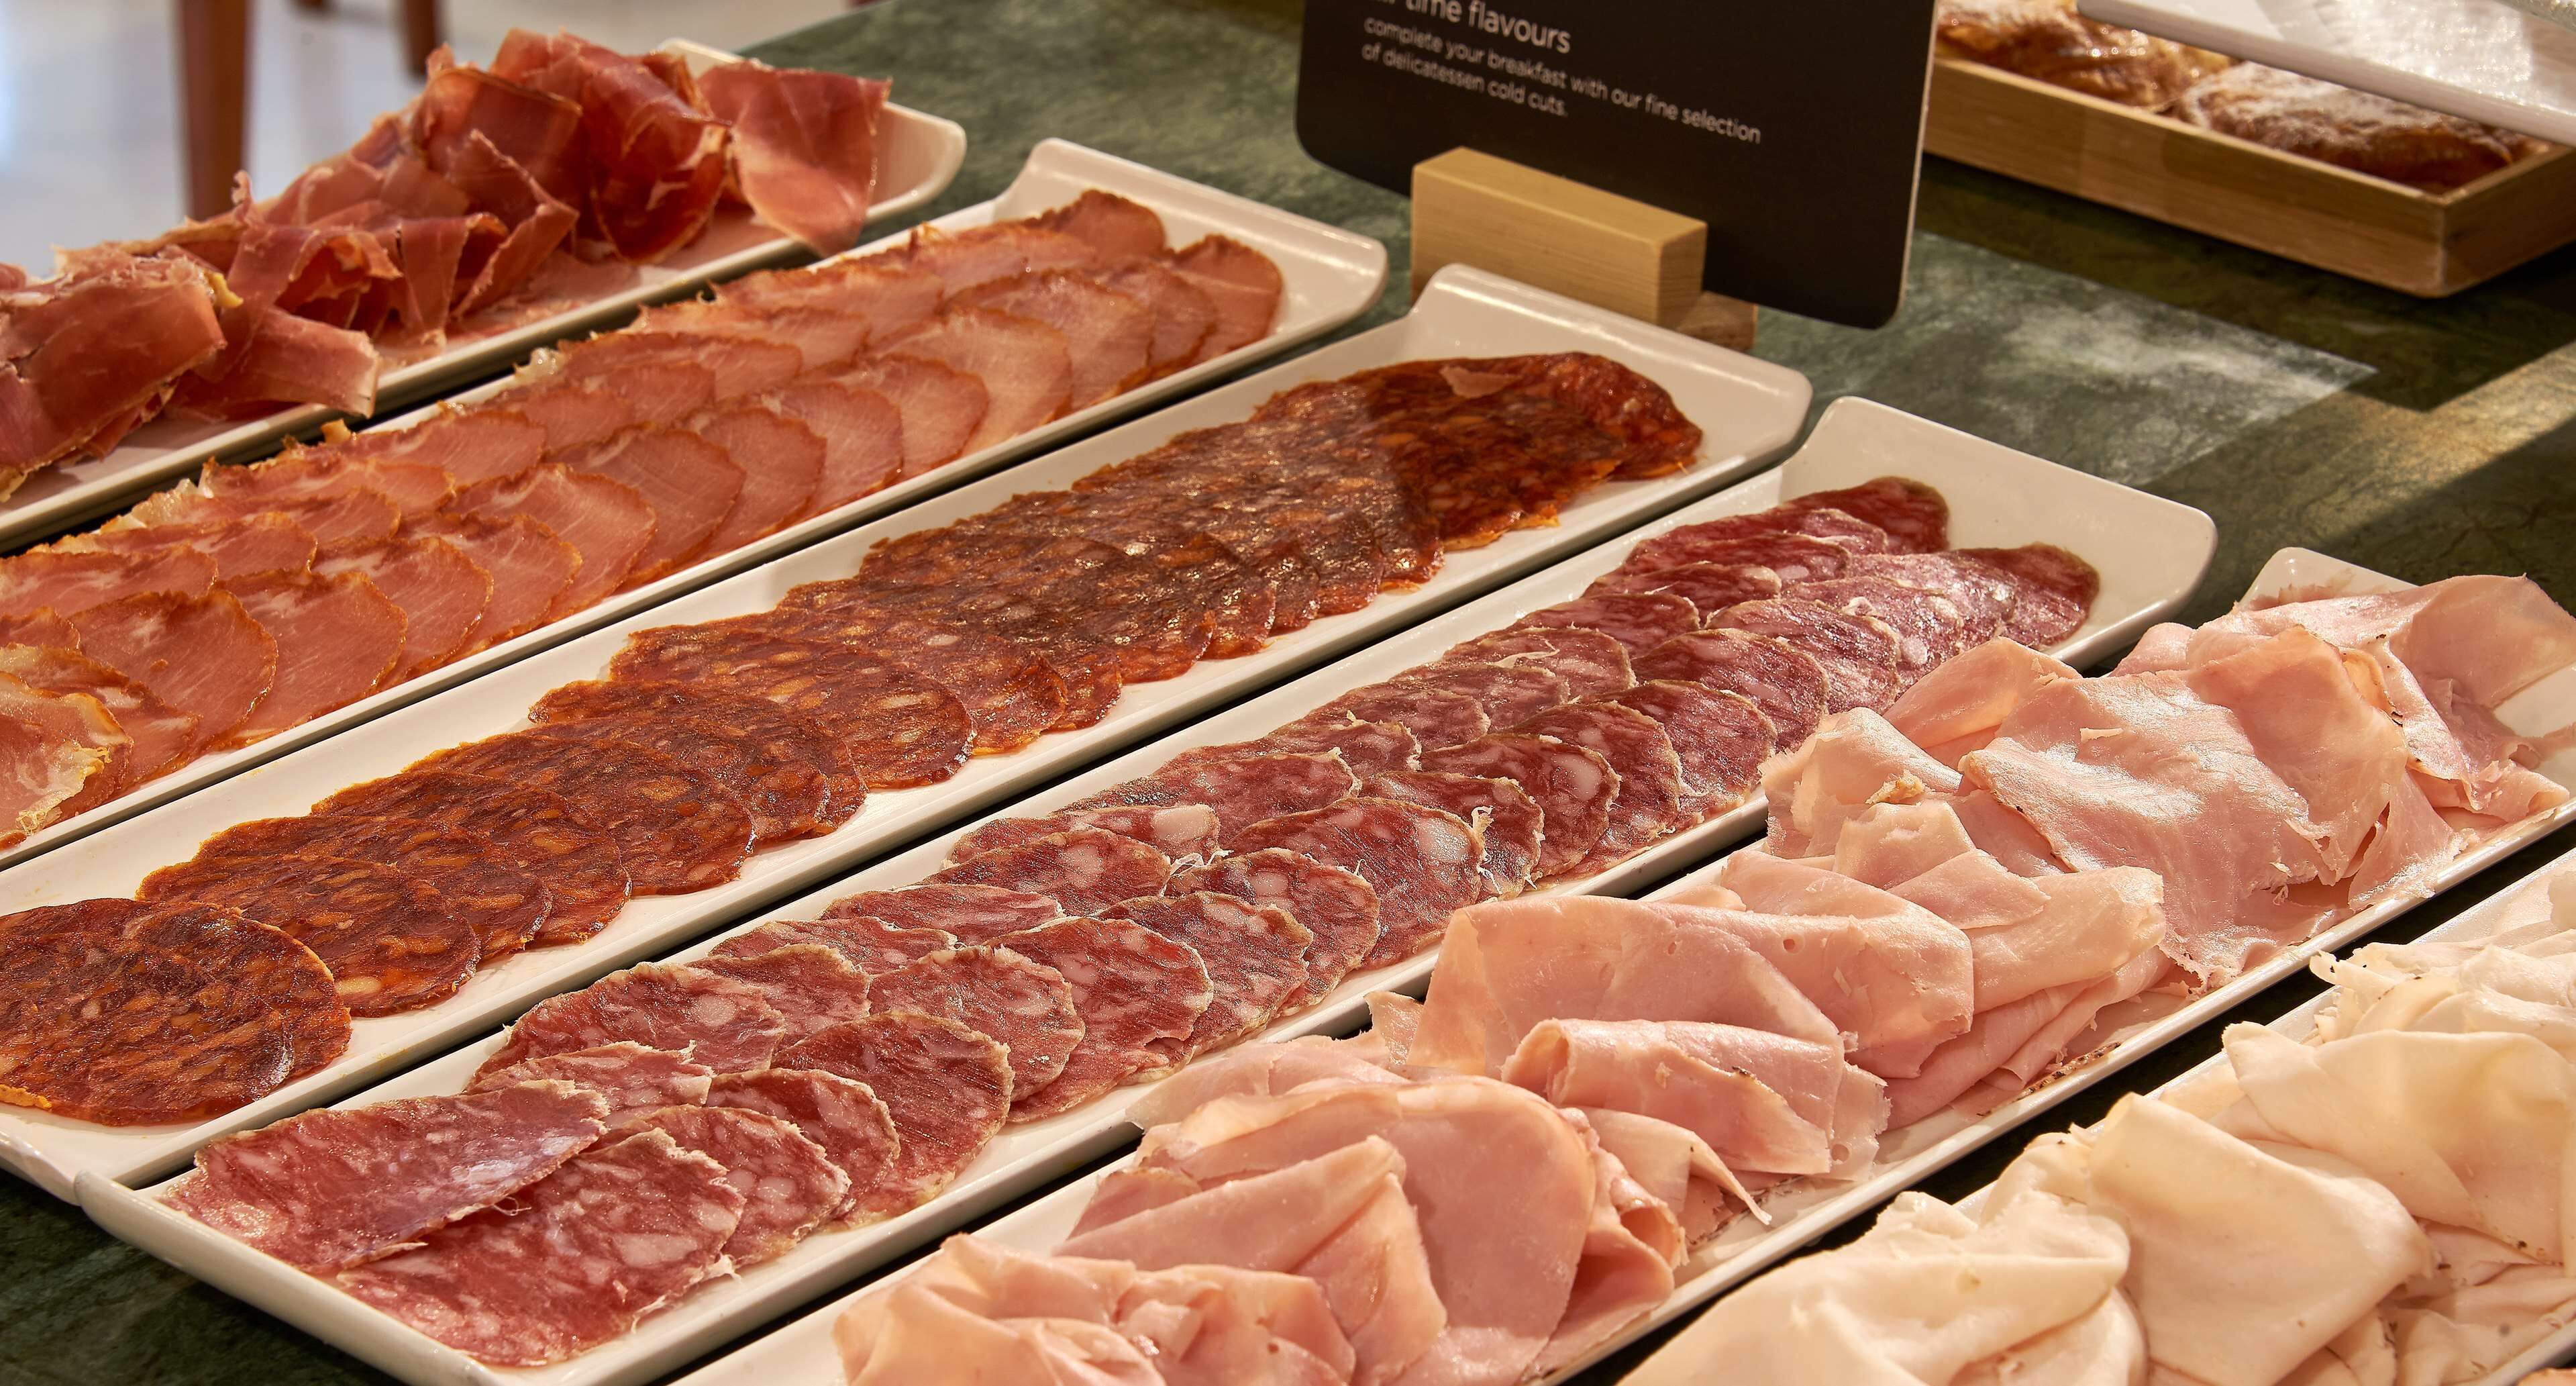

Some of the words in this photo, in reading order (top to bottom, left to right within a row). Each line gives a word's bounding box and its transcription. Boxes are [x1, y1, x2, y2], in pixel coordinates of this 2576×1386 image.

[1467, 0, 1572, 54] flavours
[1361, 43, 1380, 61] of
[1382, 50, 1485, 91] delicatessen
[1487, 81, 1527, 105] cold
[1528, 92, 1568, 117] cuts.
[1363, 17, 1444, 53] complete
[1445, 41, 1486, 62] your
[1486, 51, 1567, 89] breakfast
[1569, 78, 1608, 99] with
[1610, 89, 1643, 109] our
[1645, 93, 1679, 121] fine
[1681, 107, 1761, 144] selection
